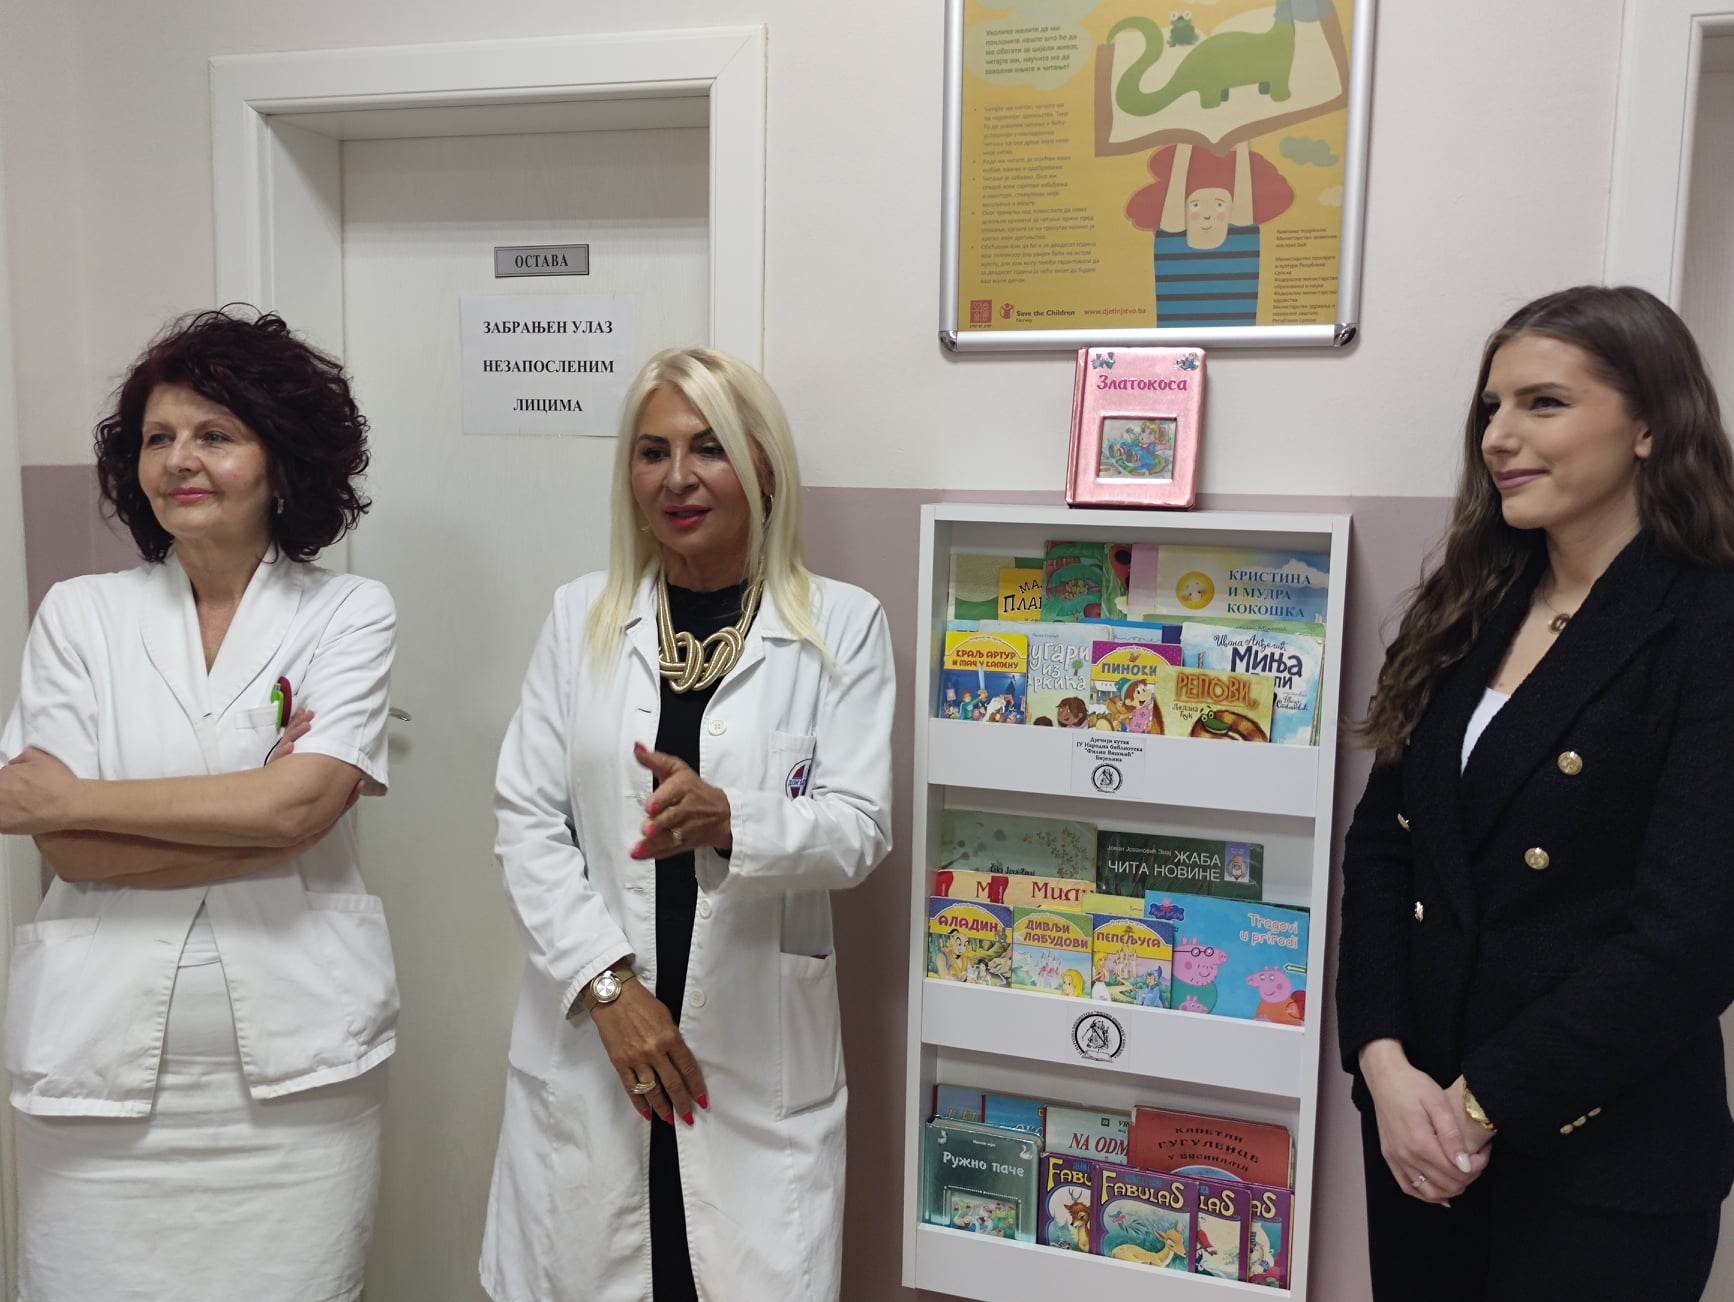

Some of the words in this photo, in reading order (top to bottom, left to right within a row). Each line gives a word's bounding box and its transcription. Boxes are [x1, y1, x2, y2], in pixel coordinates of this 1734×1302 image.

[514, 254, 569, 269] ОСТАВА
[1046, 309, 1076, 317] Children
[483, 320, 567, 334] ЗАБРАЊЕН
[571, 320, 613, 334] УЛАЗ
[482, 360, 615, 374] НЕЗАПОСЛЕНИМ
[1097, 374, 1189, 392] Златокоса
[512, 398, 583, 414] ЛИЦИМА
[1228, 569, 1312, 585] КРИСТИНА
[1228, 587, 1238, 599] И
[1242, 587, 1292, 600] МУДРА
[1227, 603, 1305, 618] КОКОШКА
[986, 649, 1016, 660] АРТУР
[1230, 645, 1303, 677] Миња
[1101, 663, 1157, 676] ПИНОКИ
[1174, 850, 1222, 867] ЖАБА
[1108, 860, 1149, 875] ЧИТА
[1154, 864, 1222, 882] НОВИНЕ
[938, 915, 998, 932] АЛАДИН
[1025, 919, 1071, 934] ДИВЉИ
[1023, 933, 1089, 950] ЛАБУДОВИ
[1068, 1132, 1091, 1151] NA
[1095, 1136, 1129, 1157] ODM
[942, 1151, 987, 1169] Ружно
[991, 1162, 1025, 1178] паче
[1100, 1169, 1185, 1209] FABULAS
[1199, 1190, 1235, 1217] LAS
